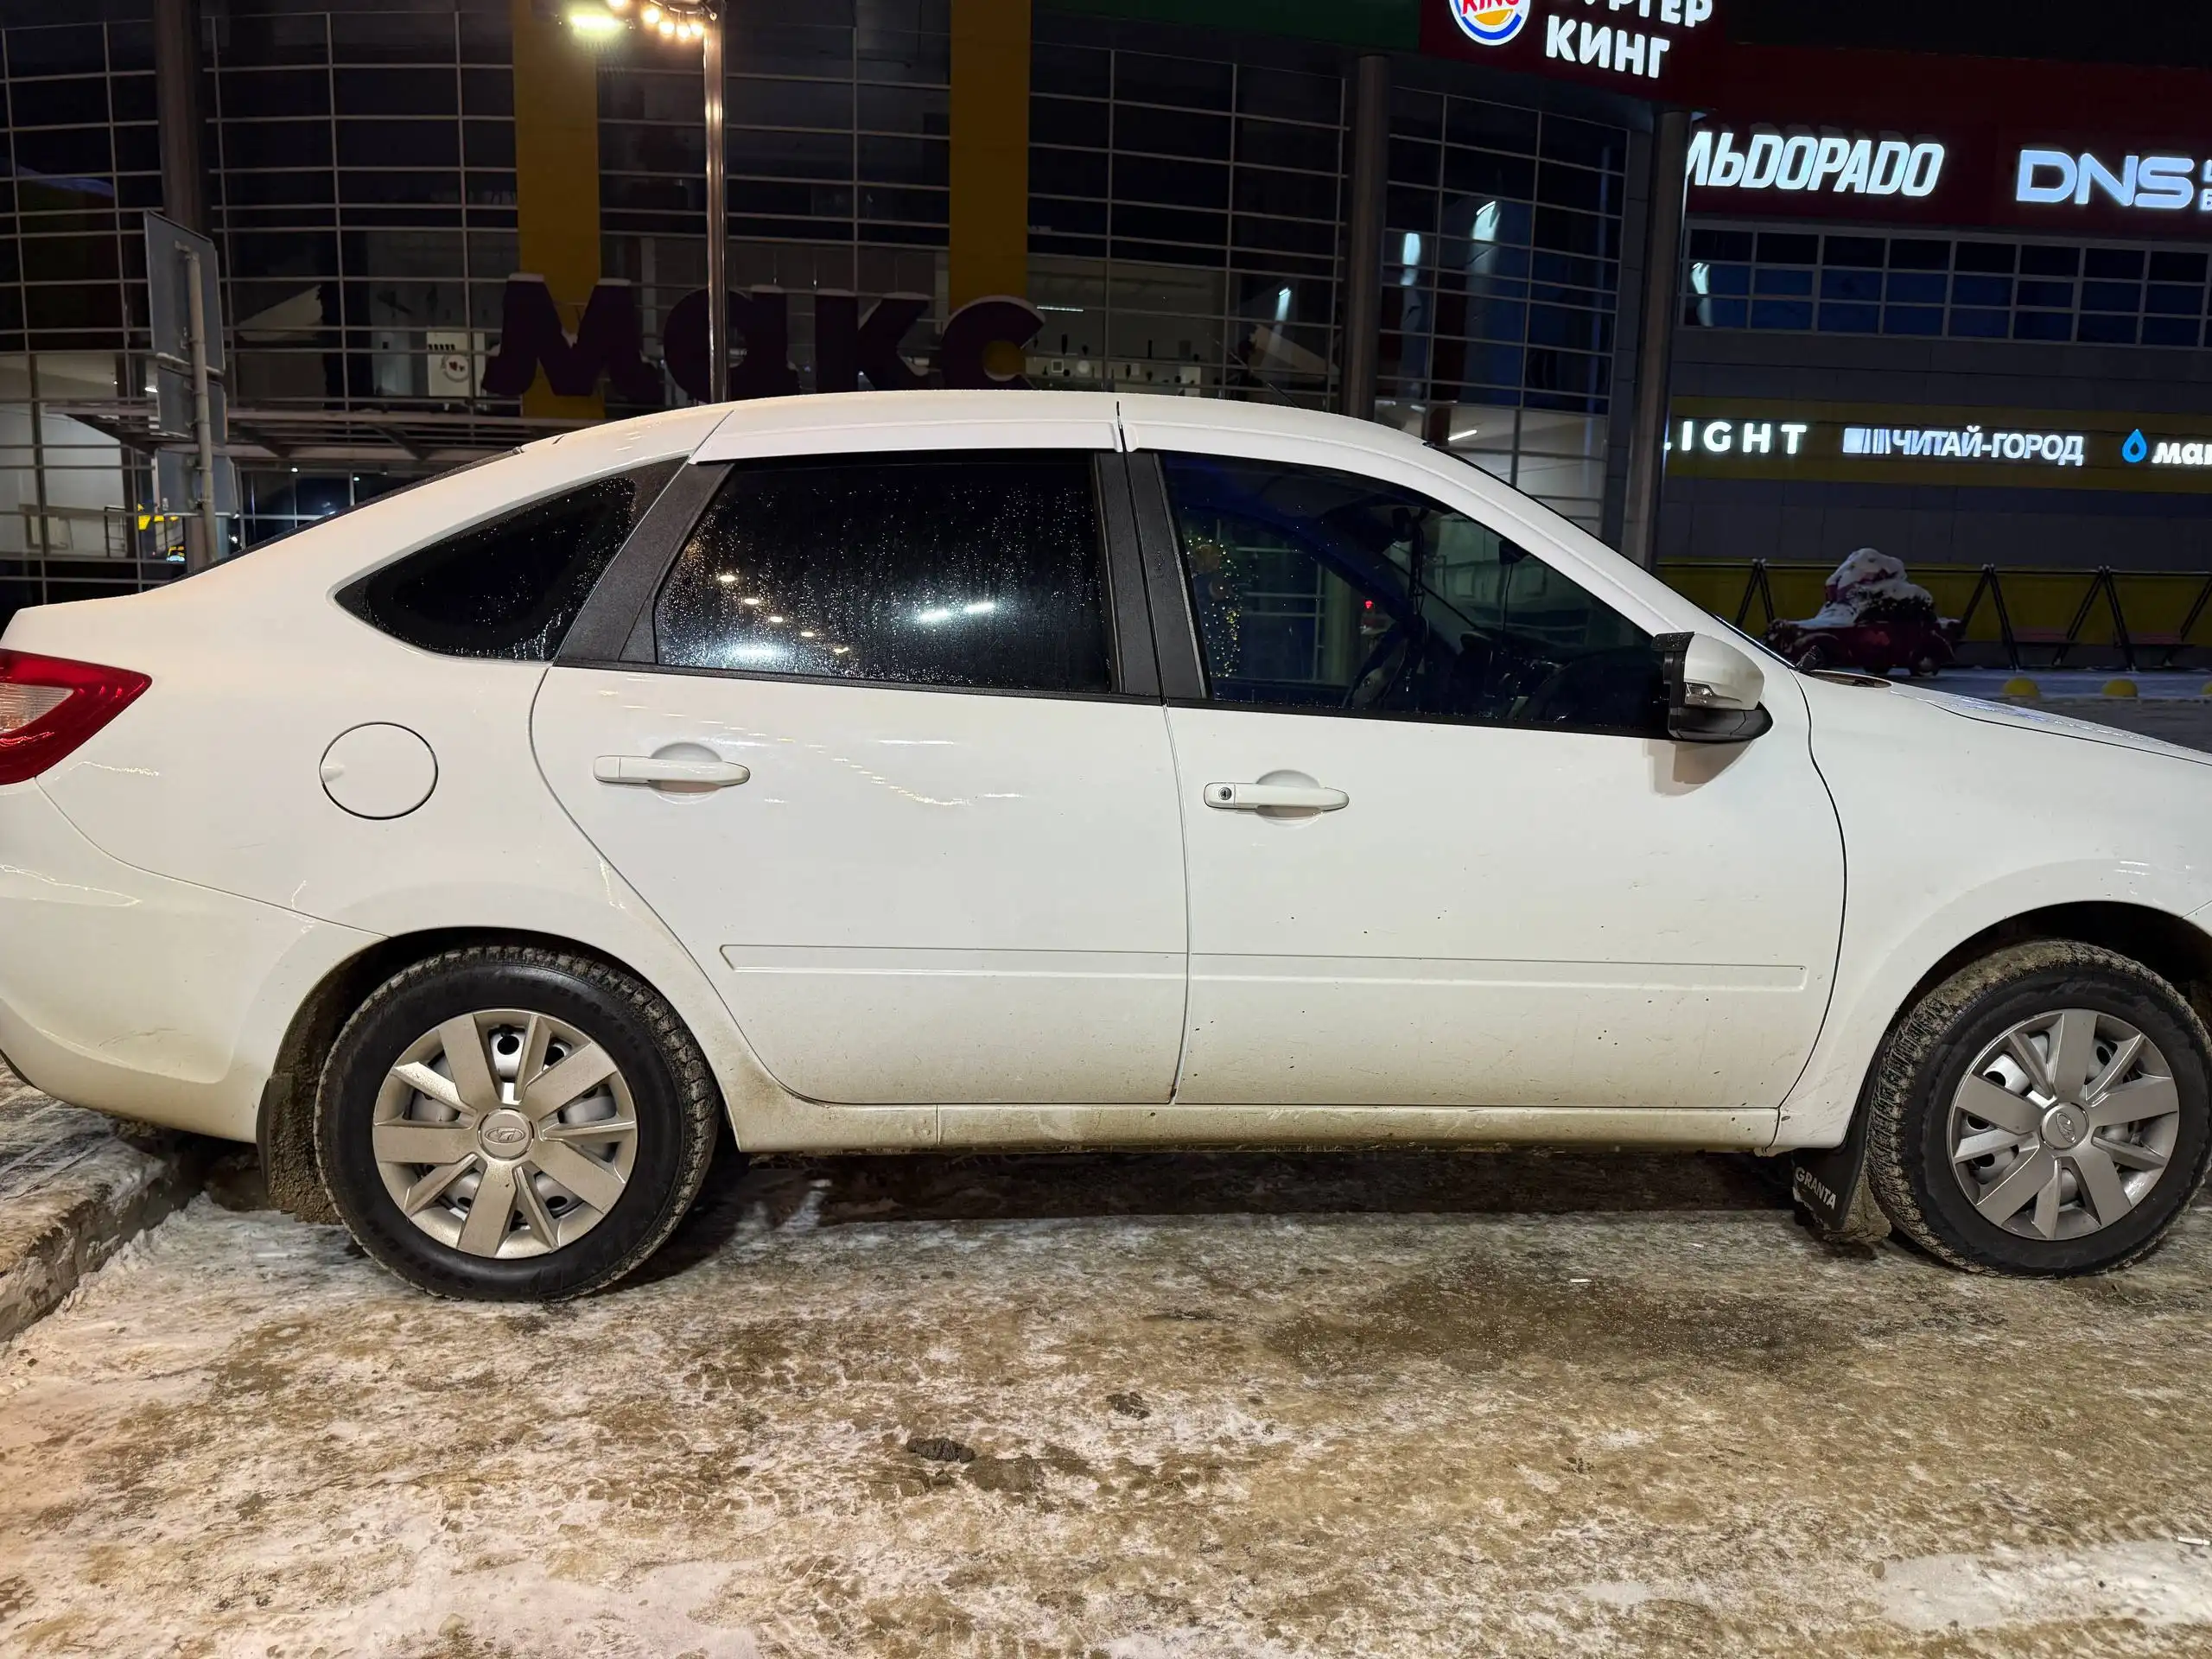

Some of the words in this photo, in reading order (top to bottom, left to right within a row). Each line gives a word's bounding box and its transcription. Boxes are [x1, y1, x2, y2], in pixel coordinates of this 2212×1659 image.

[1545, 14, 1671, 79] КИНГ
[2015, 149, 2196, 209] DNS
[1663, 420, 1808, 455] IGHT
[1891, 424, 2085, 467] ЧИТАЙ-ГОРОД
[1794, 1166, 1838, 1211] GRANTA
